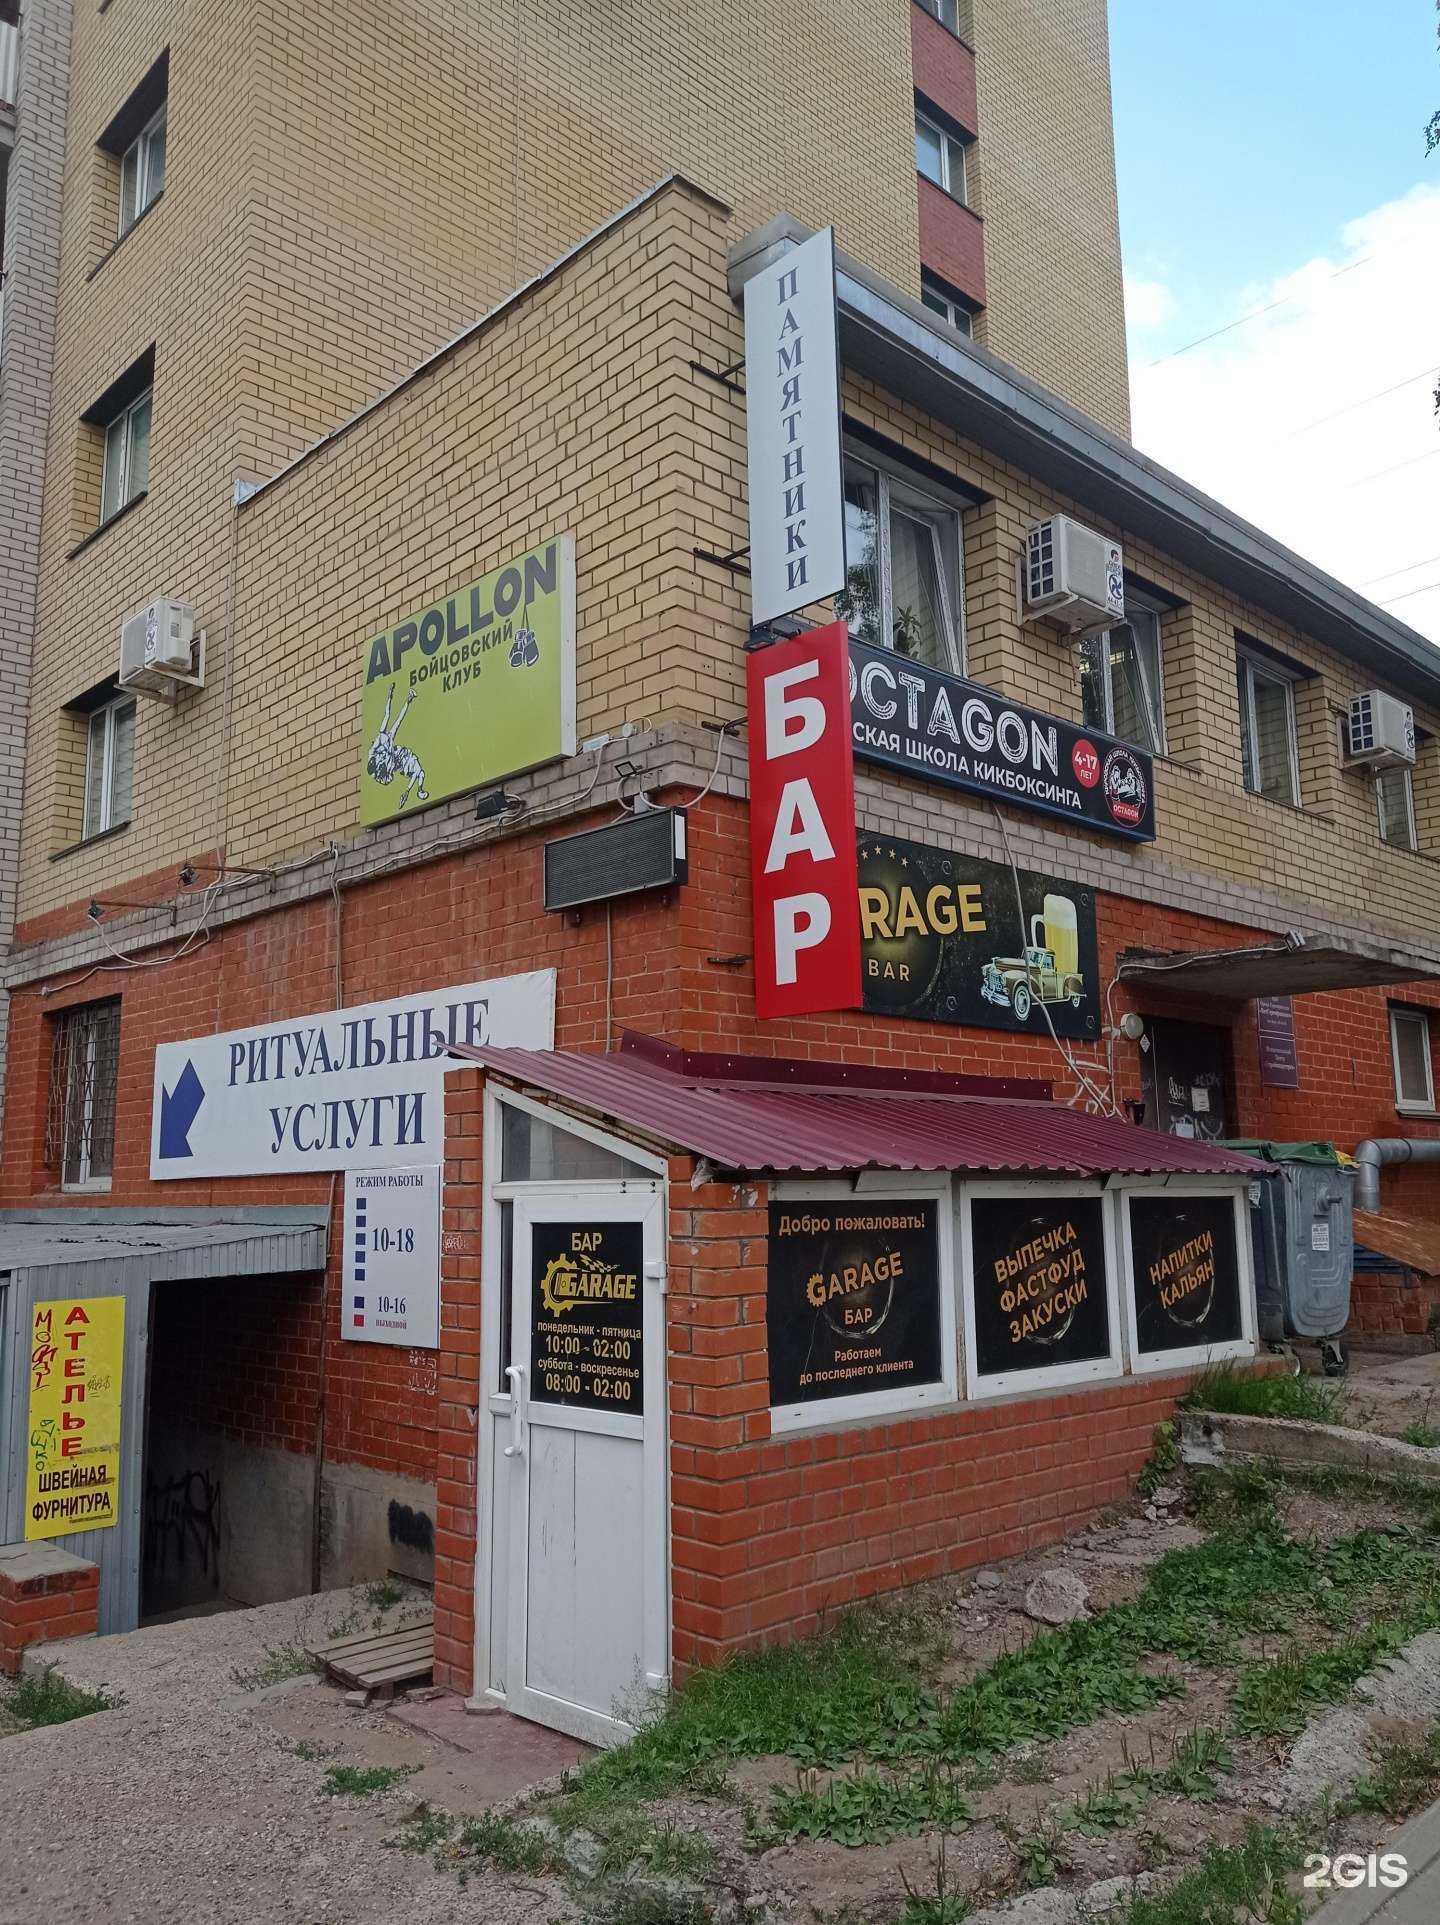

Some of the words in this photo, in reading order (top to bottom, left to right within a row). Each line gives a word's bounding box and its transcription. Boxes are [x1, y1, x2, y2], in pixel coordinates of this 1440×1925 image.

[776, 266, 810, 592] ПАМЯТНИКИ
[366, 543, 557, 685] APOLLON
[409, 617, 513, 688] БОЙЦОВСКИЙ
[443, 660, 482, 693] КЛУБ
[849, 656, 1058, 777] CTAGON
[905, 738, 970, 775] ШКОЛА
[973, 760, 1082, 809] КИКБОКСИНГА
[1074, 751, 1098, 770] 4-17
[1080, 769, 1093, 780] ЛЕТ
[763, 659, 836, 986] БАР
[868, 958, 910, 982] BAR
[227, 999, 490, 1086] РИТУАЛЬНЫЕ
[269, 1092, 426, 1154] УСЛУГИ
[355, 1176, 386, 1188] РЕЖИМ
[388, 1175, 423, 1187] РАБОТЫ
[778, 1214, 831, 1236] Добро
[835, 1212, 926, 1232] пожаловать!
[372, 1227, 414, 1253] 10-18
[571, 1232, 603, 1252] БАР
[994, 1221, 1078, 1283] ВЫПЕЧКА
[1150, 1230, 1213, 1286] НАПИТКИ
[567, 1272, 637, 1299] GARAGE
[806, 1251, 904, 1308] GARAGE
[1000, 1248, 1086, 1313] ФАСТФУД
[1160, 1258, 1215, 1310] КАЛЬЯН
[378, 1296, 406, 1314] 10-16
[844, 1307, 873, 1325] БАР
[1009, 1278, 1088, 1343] ЗАКУСКИ
[537, 1321, 595, 1336] понедельник
[602, 1326, 642, 1340] пятница
[545, 1334, 580, 1354] 10:00
[593, 1339, 631, 1360] 02:00
[834, 1348, 882, 1363] Работаем
[61, 1306, 90, 1457] АТЕЛЬЕ
[538, 1358, 573, 1373] суббота
[581, 1360, 640, 1378] воскресенье
[800, 1371, 813, 1386] до
[815, 1364, 874, 1382] последнего
[876, 1359, 914, 1373] клиента
[545, 1372, 581, 1394] 08:00
[593, 1378, 631, 1400] 02:00
[38, 1464, 107, 1493] ШВЕЙНАЯ
[32, 1492, 111, 1522] ФУРНИТУРА
